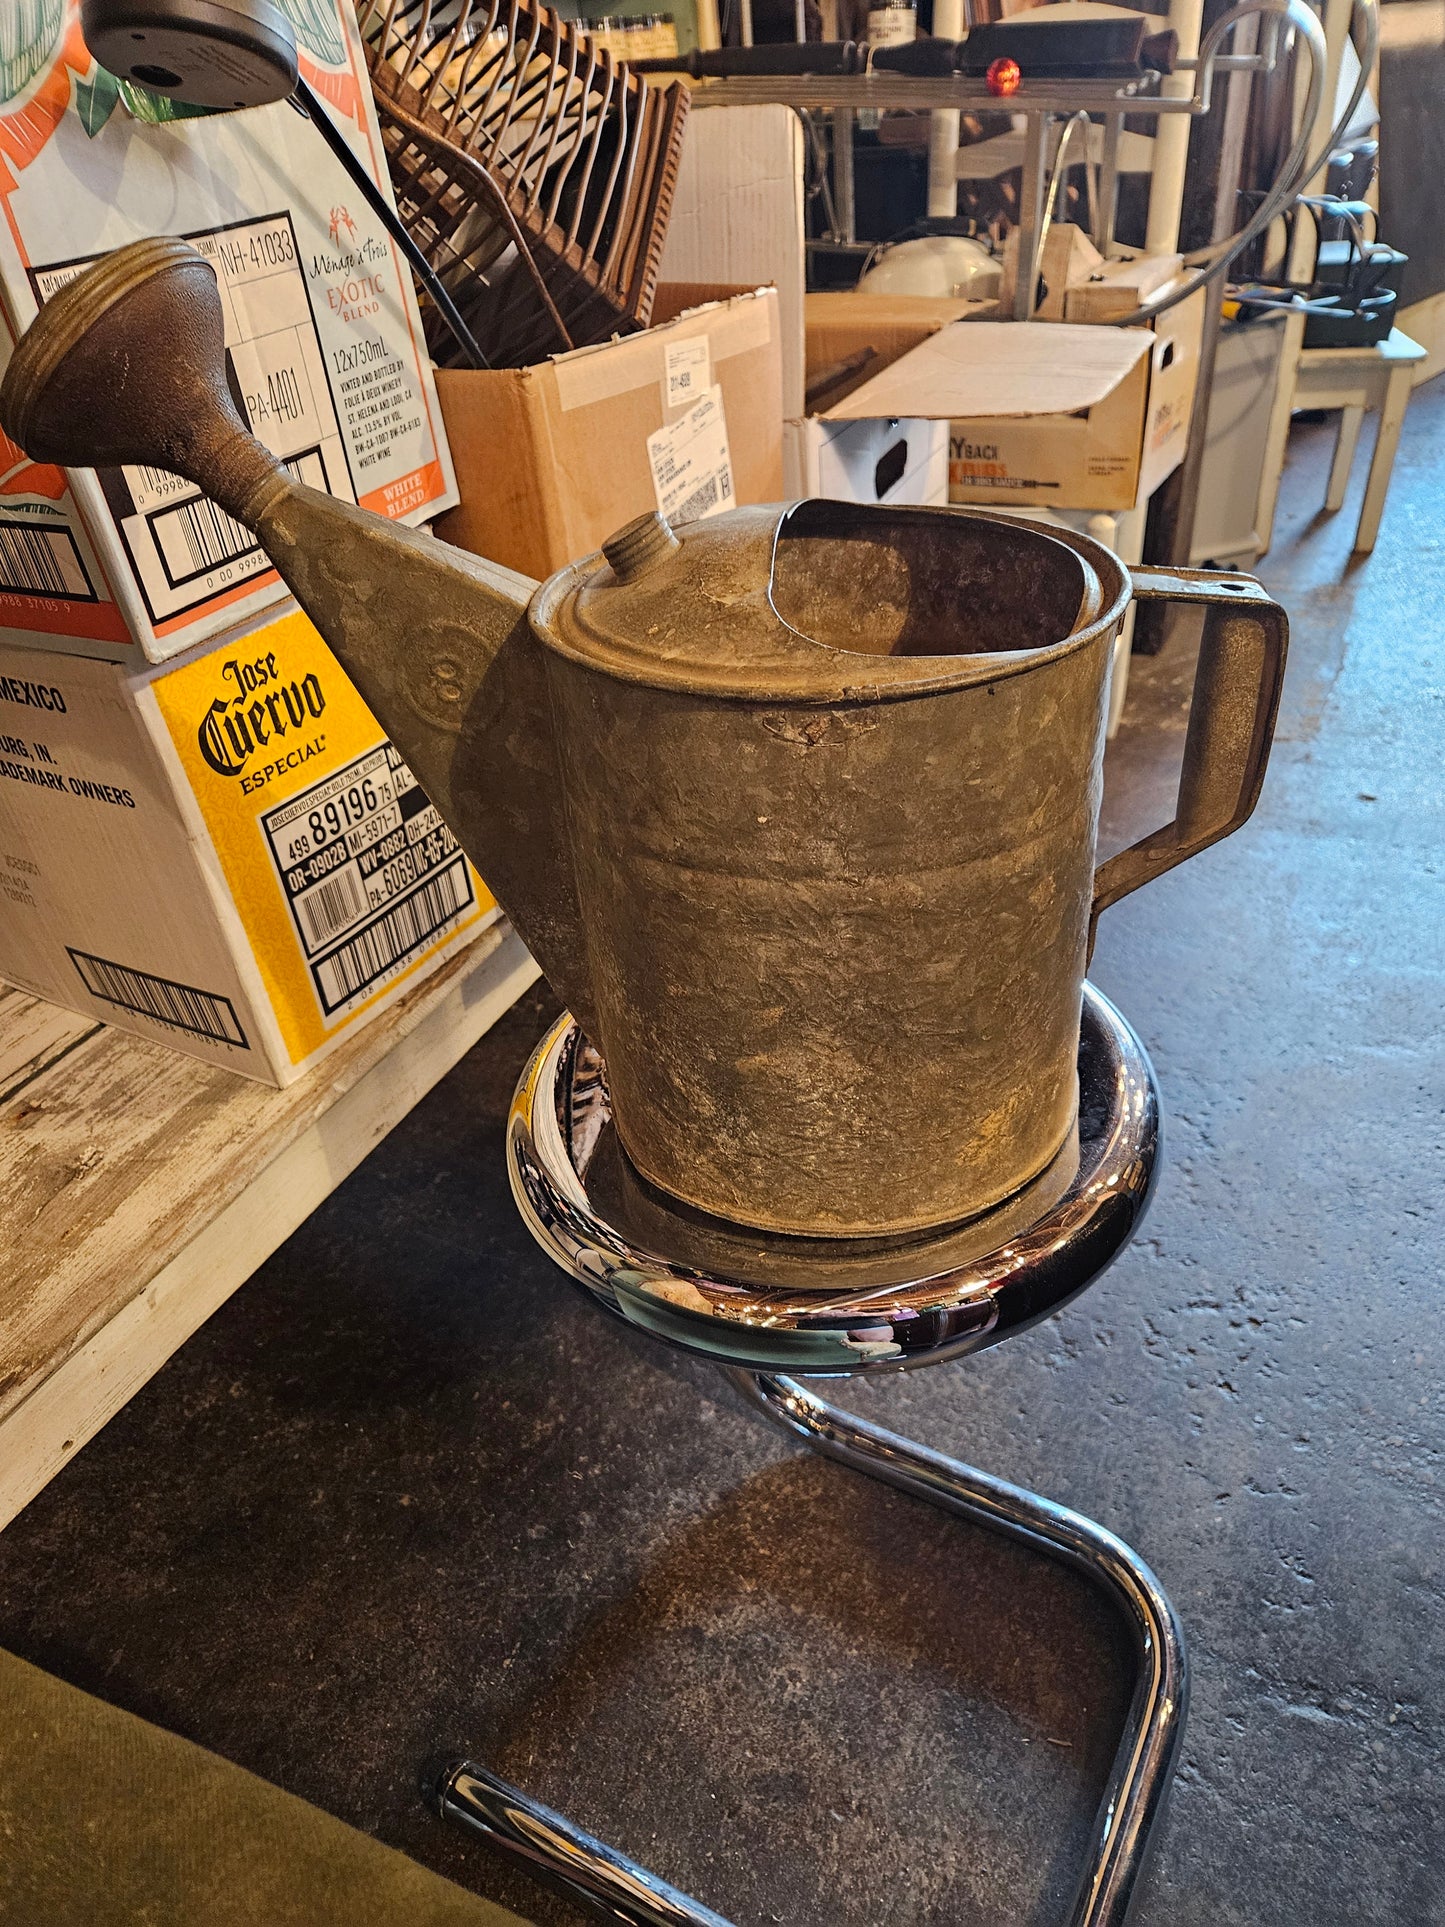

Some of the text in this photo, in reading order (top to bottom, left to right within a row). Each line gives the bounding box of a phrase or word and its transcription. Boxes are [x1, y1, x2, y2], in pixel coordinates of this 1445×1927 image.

[220, 230, 294, 276] NH-41033
[310, 253, 354, 279] Ménage
[363, 237, 388, 262] Trois
[326, 273, 385, 316] EXOTIC
[343, 301, 379, 322] BLEND
[246, 367, 304, 424] PA-4401
[340, 360, 404, 394] VINTED AND BOTTLED BY
[344, 394, 361, 409] FOLIE
[366, 387, 381, 401] DEUX
[381, 377, 402, 393] WINERY
[357, 404, 378, 421] HELENA
[380, 399, 390, 411] AND
[405, 389, 412, 400] CA
[383, 415, 391, 426] BY
[359, 447, 391, 469] WHITE WINE
[382, 472, 423, 502] WHITE
[386, 489, 425, 517] BLEND
[222, 651, 279, 707] Jose
[198, 673, 326, 777] Cuervo
[0, 734, 58, 765] URG, IN.
[0, 761, 136, 808] ADEMARK OWNERS
[289, 778, 392, 861] 499 89196 75
[347, 806, 399, 854] MI-5971-7
[286, 841, 347, 893] OR-0902B
[358, 829, 407, 875] WV-0882
[369, 853, 416, 909] PA-6069
[381, 954, 414, 984] 11538
